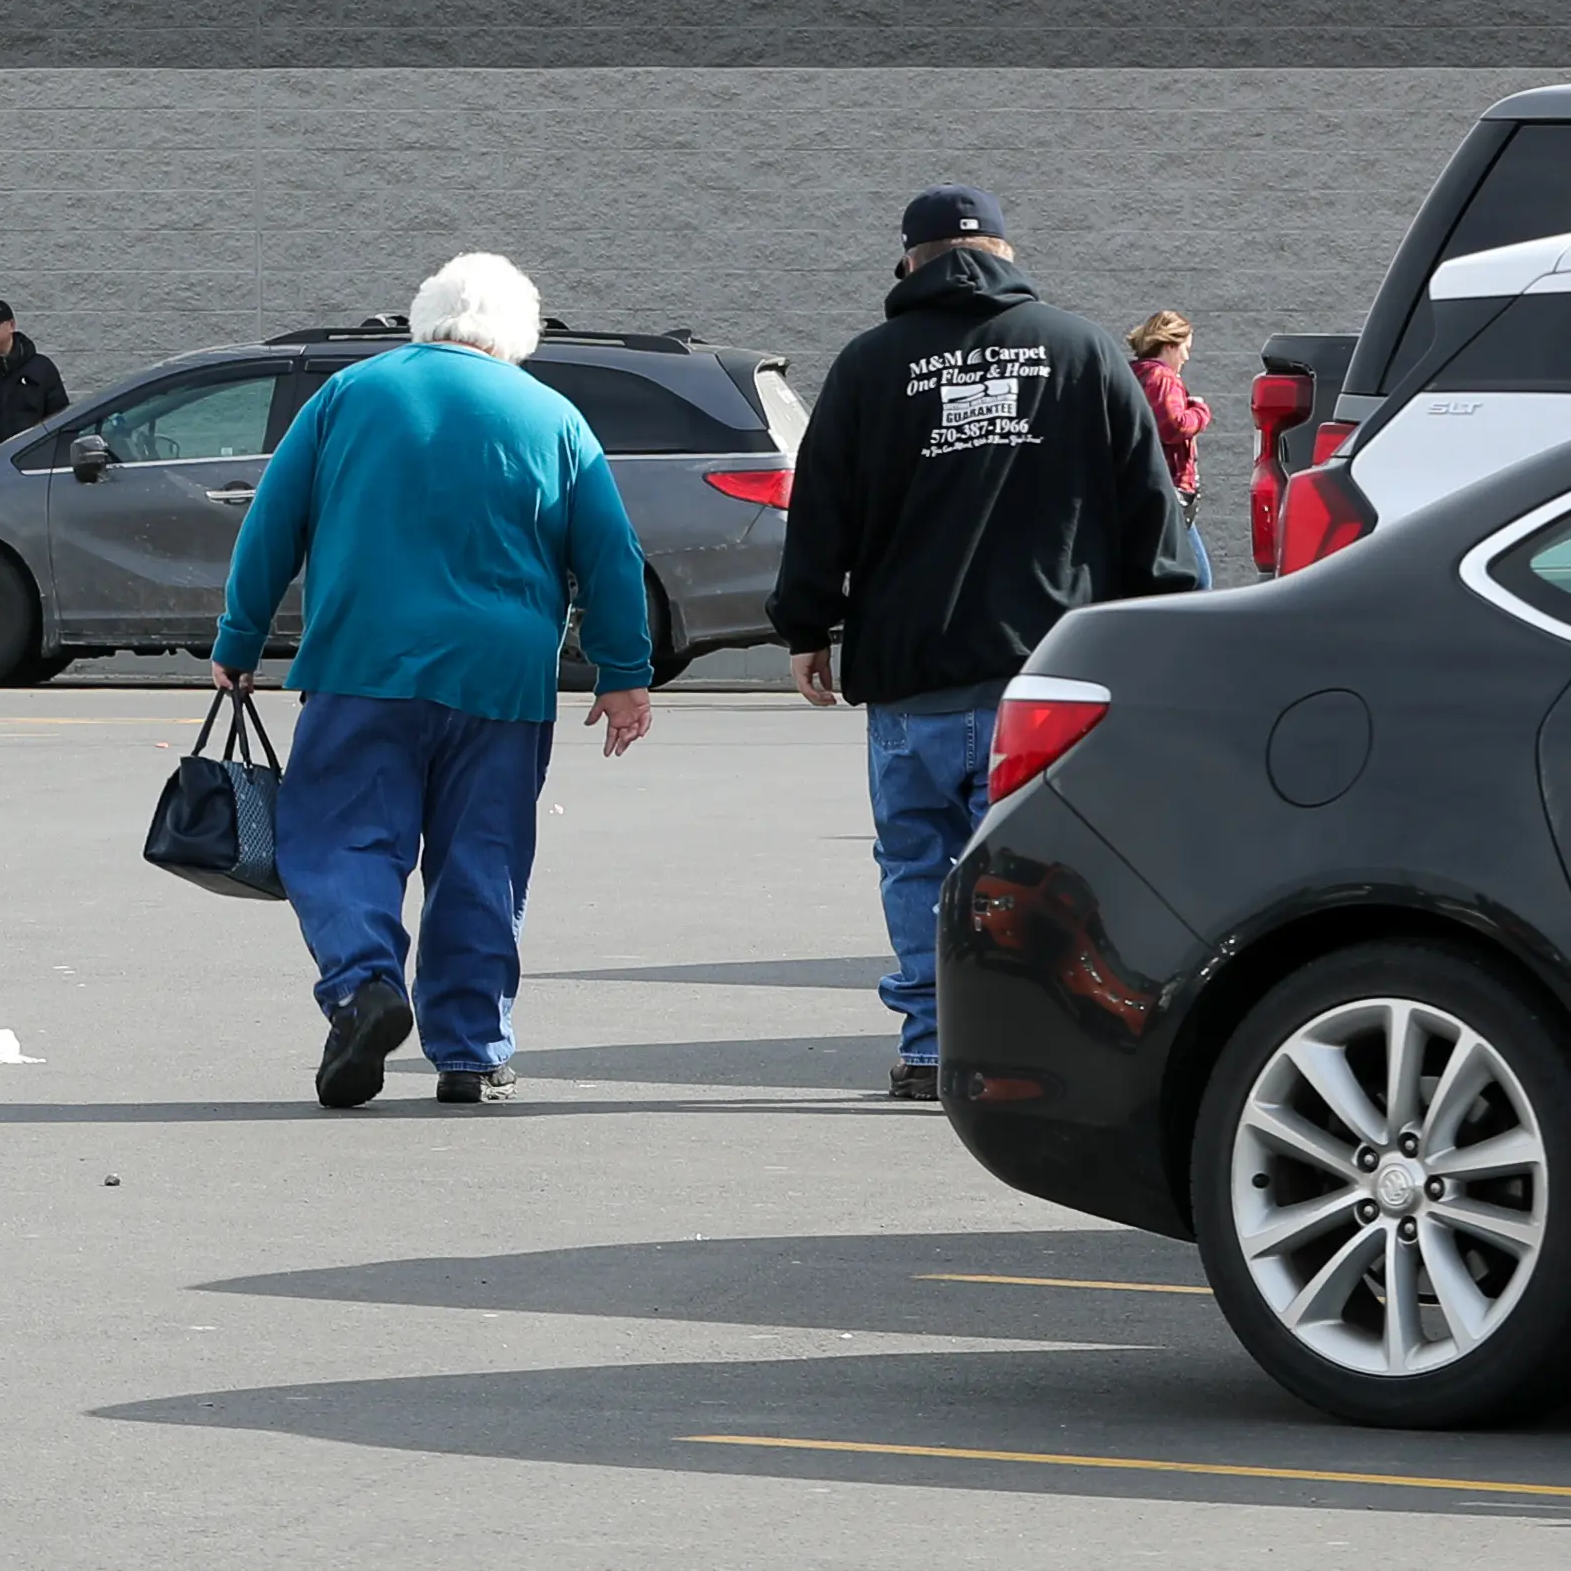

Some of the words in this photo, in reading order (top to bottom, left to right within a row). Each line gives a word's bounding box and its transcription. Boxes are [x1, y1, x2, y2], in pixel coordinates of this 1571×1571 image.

[909, 350, 963, 378] M&M
[984, 345, 1047, 363] Carpet
[906, 377, 938, 396] One
[940, 368, 984, 384] Floor
[986, 363, 1001, 378] &
[1004, 362, 1051, 378] Home
[946, 403, 1013, 423] GUARANTEE
[1428, 401, 1484, 416] SLT
[930, 418, 1029, 444] 570-387-1966
